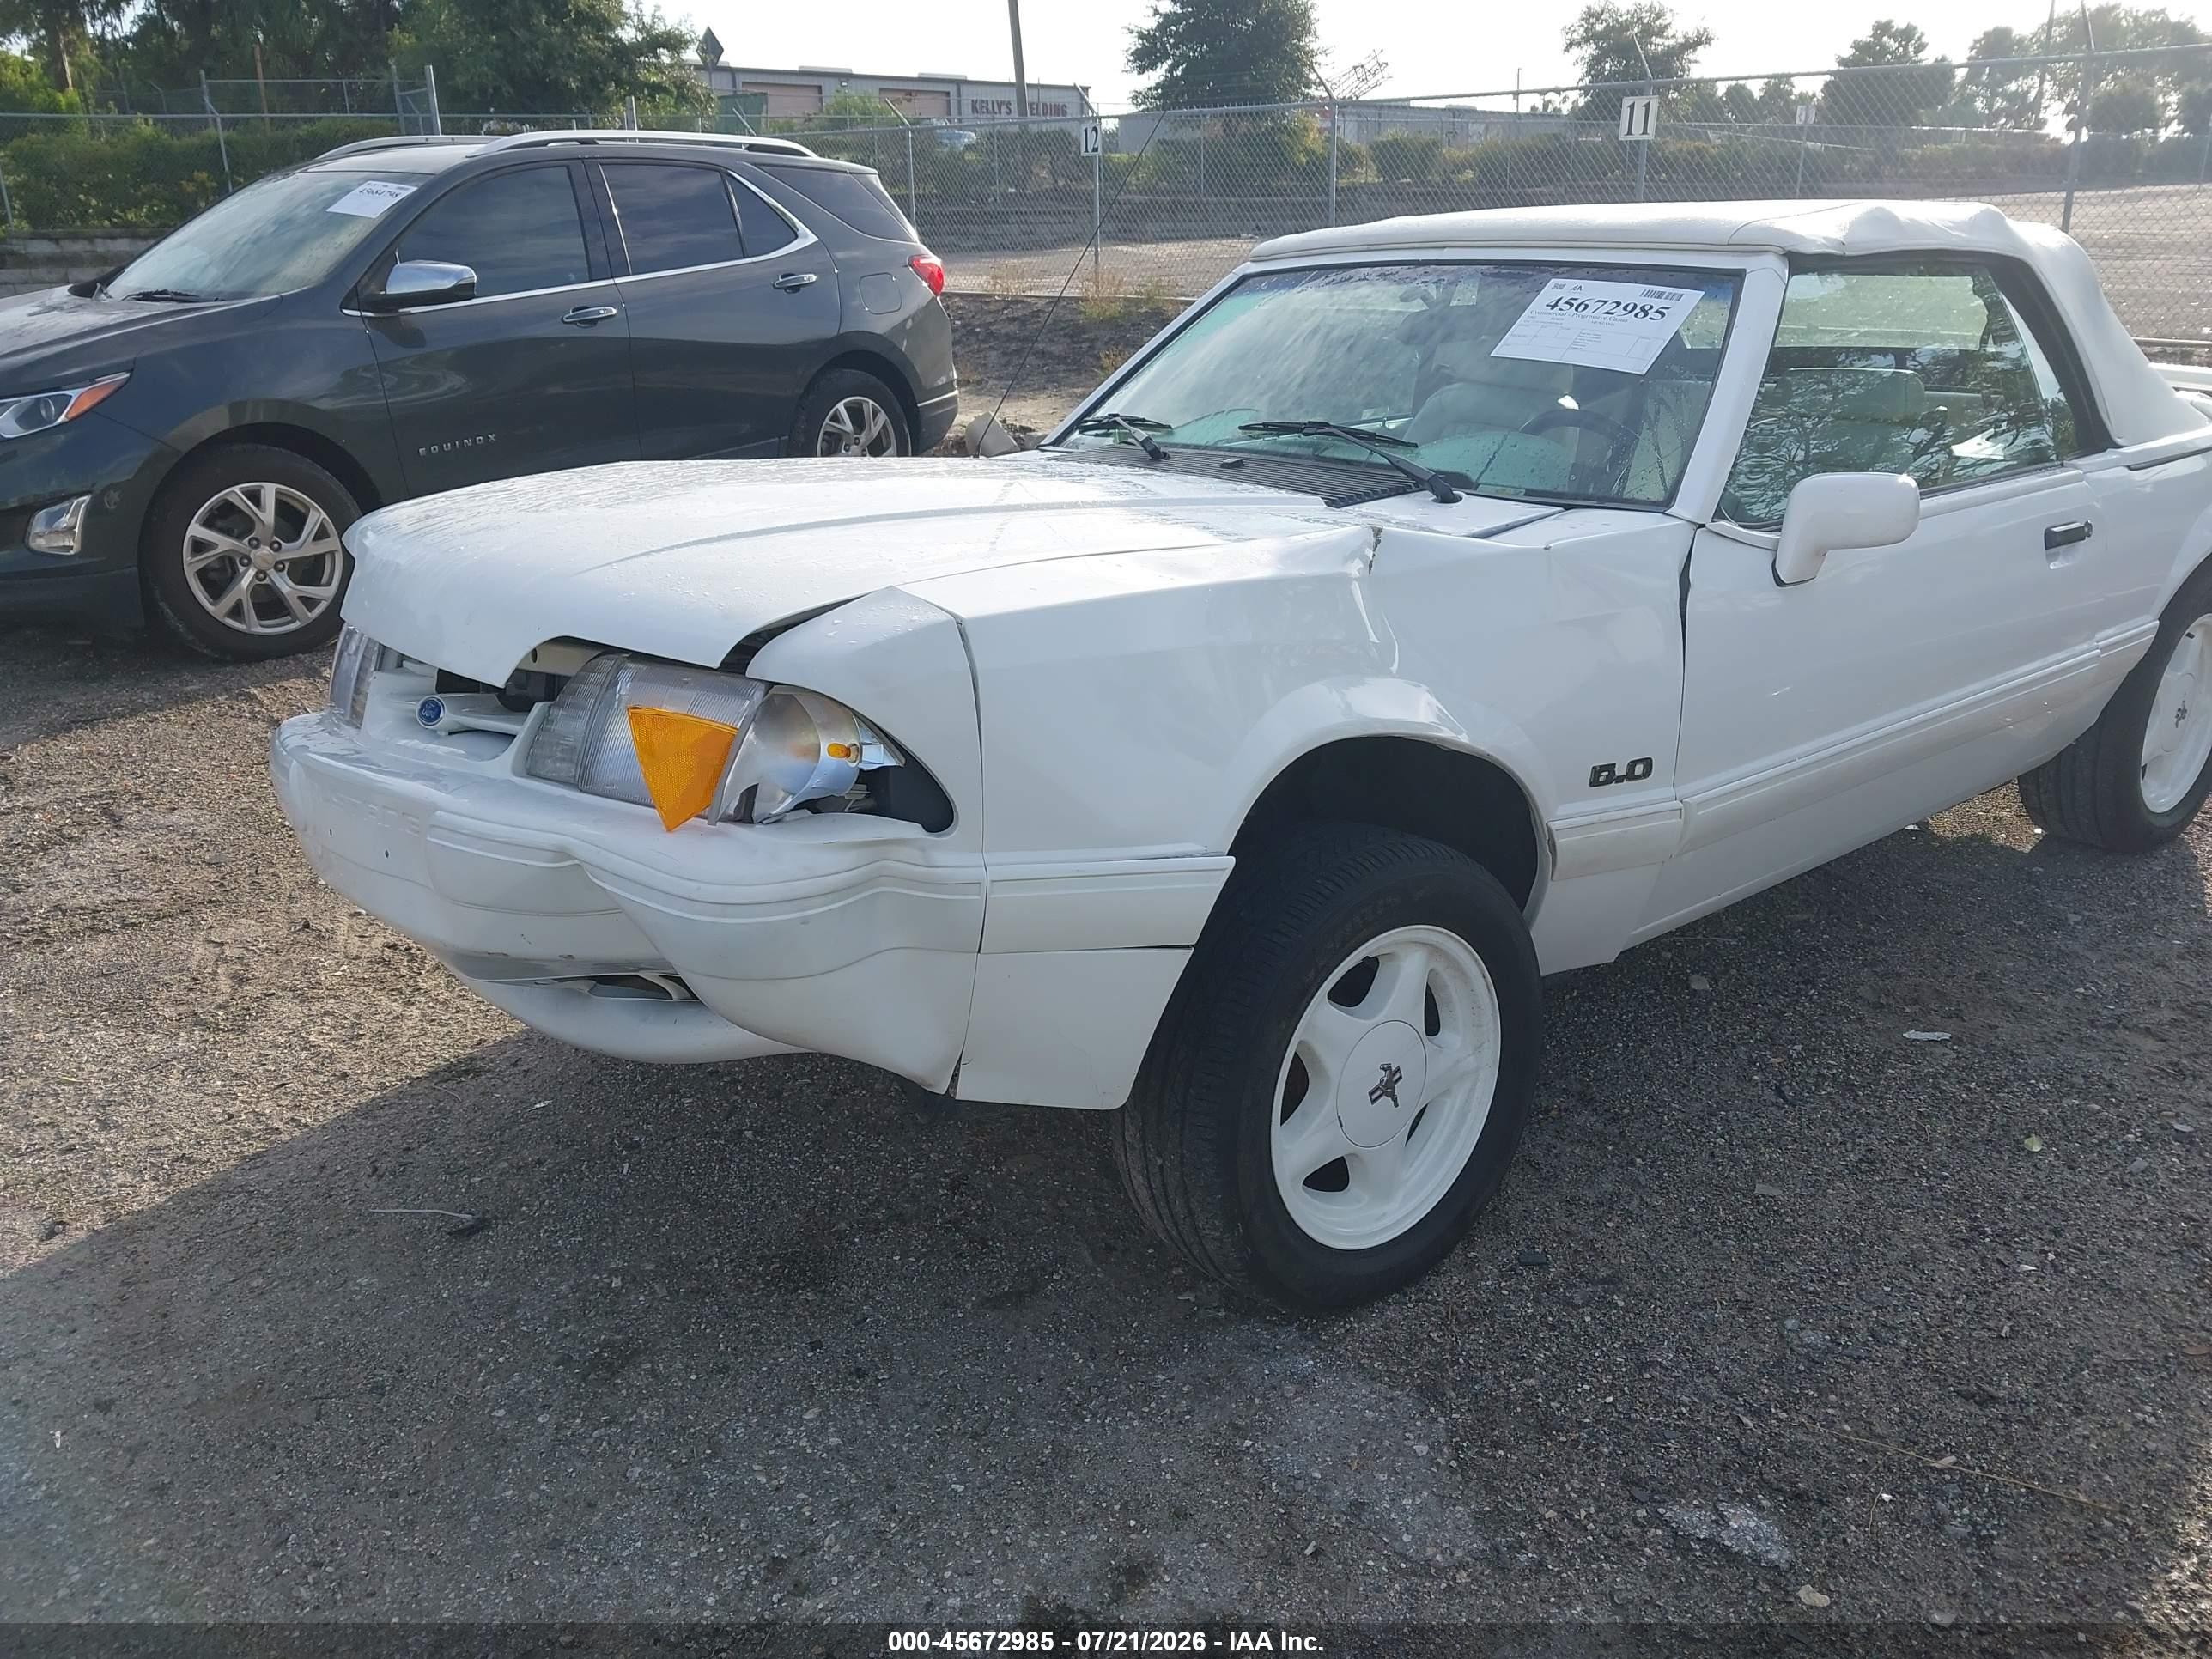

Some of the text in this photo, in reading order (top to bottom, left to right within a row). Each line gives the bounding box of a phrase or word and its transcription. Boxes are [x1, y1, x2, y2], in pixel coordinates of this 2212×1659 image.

[970, 99, 1067, 117] KELLY'S ELDING
[1624, 100, 1651, 136] 11
[1084, 125, 1099, 153] 12
[1546, 295, 1673, 321] 45672985
[418, 433, 495, 457] EQUINOX
